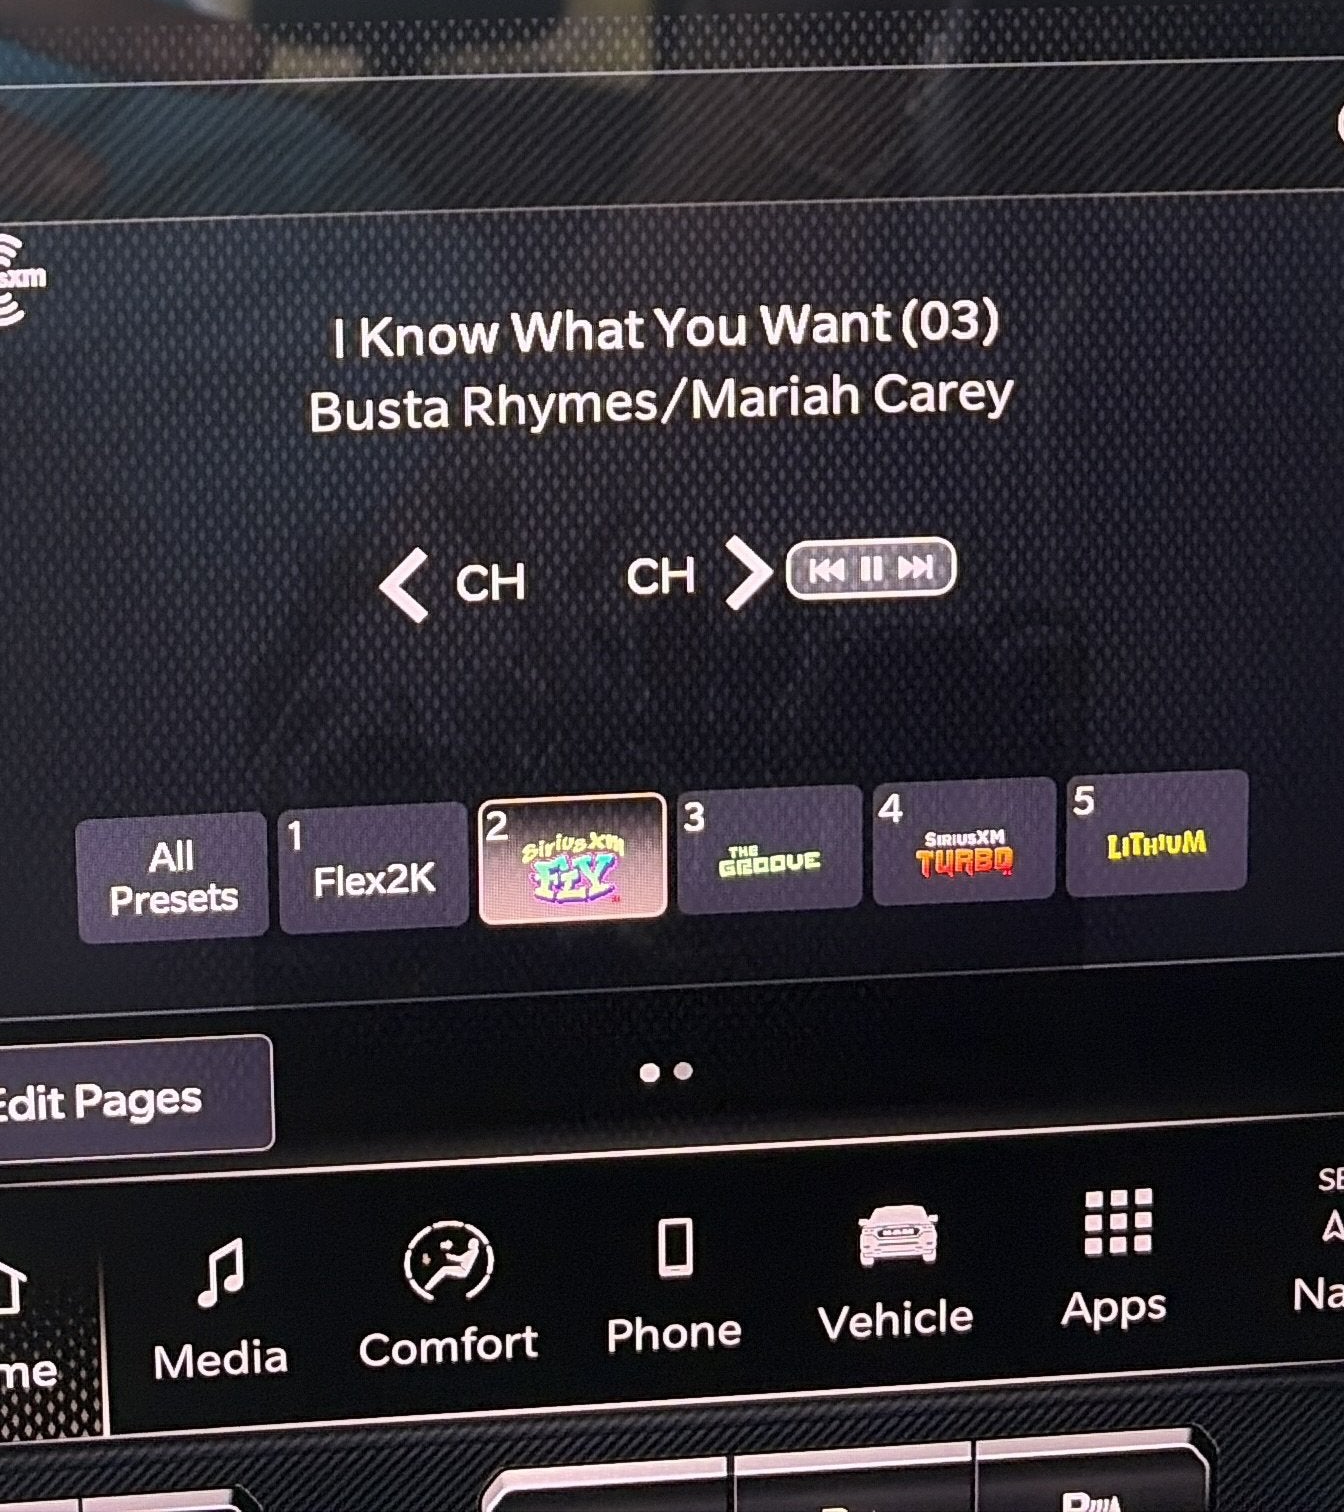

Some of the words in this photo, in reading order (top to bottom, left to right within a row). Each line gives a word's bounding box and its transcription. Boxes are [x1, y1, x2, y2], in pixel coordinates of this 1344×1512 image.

[334, 319, 345, 360] I
[360, 316, 499, 359] Know
[511, 309, 645, 355] What
[657, 306, 748, 349] You
[761, 300, 893, 346] Want
[901, 295, 1000, 347] (03)
[310, 389, 450, 433] Busta
[873, 372, 1015, 420] Carey
[456, 562, 527, 602] CH
[627, 556, 696, 595] CH
[683, 802, 706, 833] 3
[877, 793, 904, 824] 4
[1072, 784, 1096, 816] 5
[287, 821, 302, 851] 1
[485, 810, 509, 841] 2
[148, 840, 194, 874] All
[728, 844, 759, 859] THE
[915, 846, 1014, 879] TURBO
[314, 862, 437, 899] Flex2K
[110, 883, 240, 918] Presets
[75, 1082, 203, 1126] Pages
[817, 1298, 976, 1342] Vehicle
[1061, 1290, 1168, 1332] Apps
[359, 1324, 540, 1368] Comfort
[607, 1315, 743, 1354] Phone
[153, 1339, 289, 1380] Media
